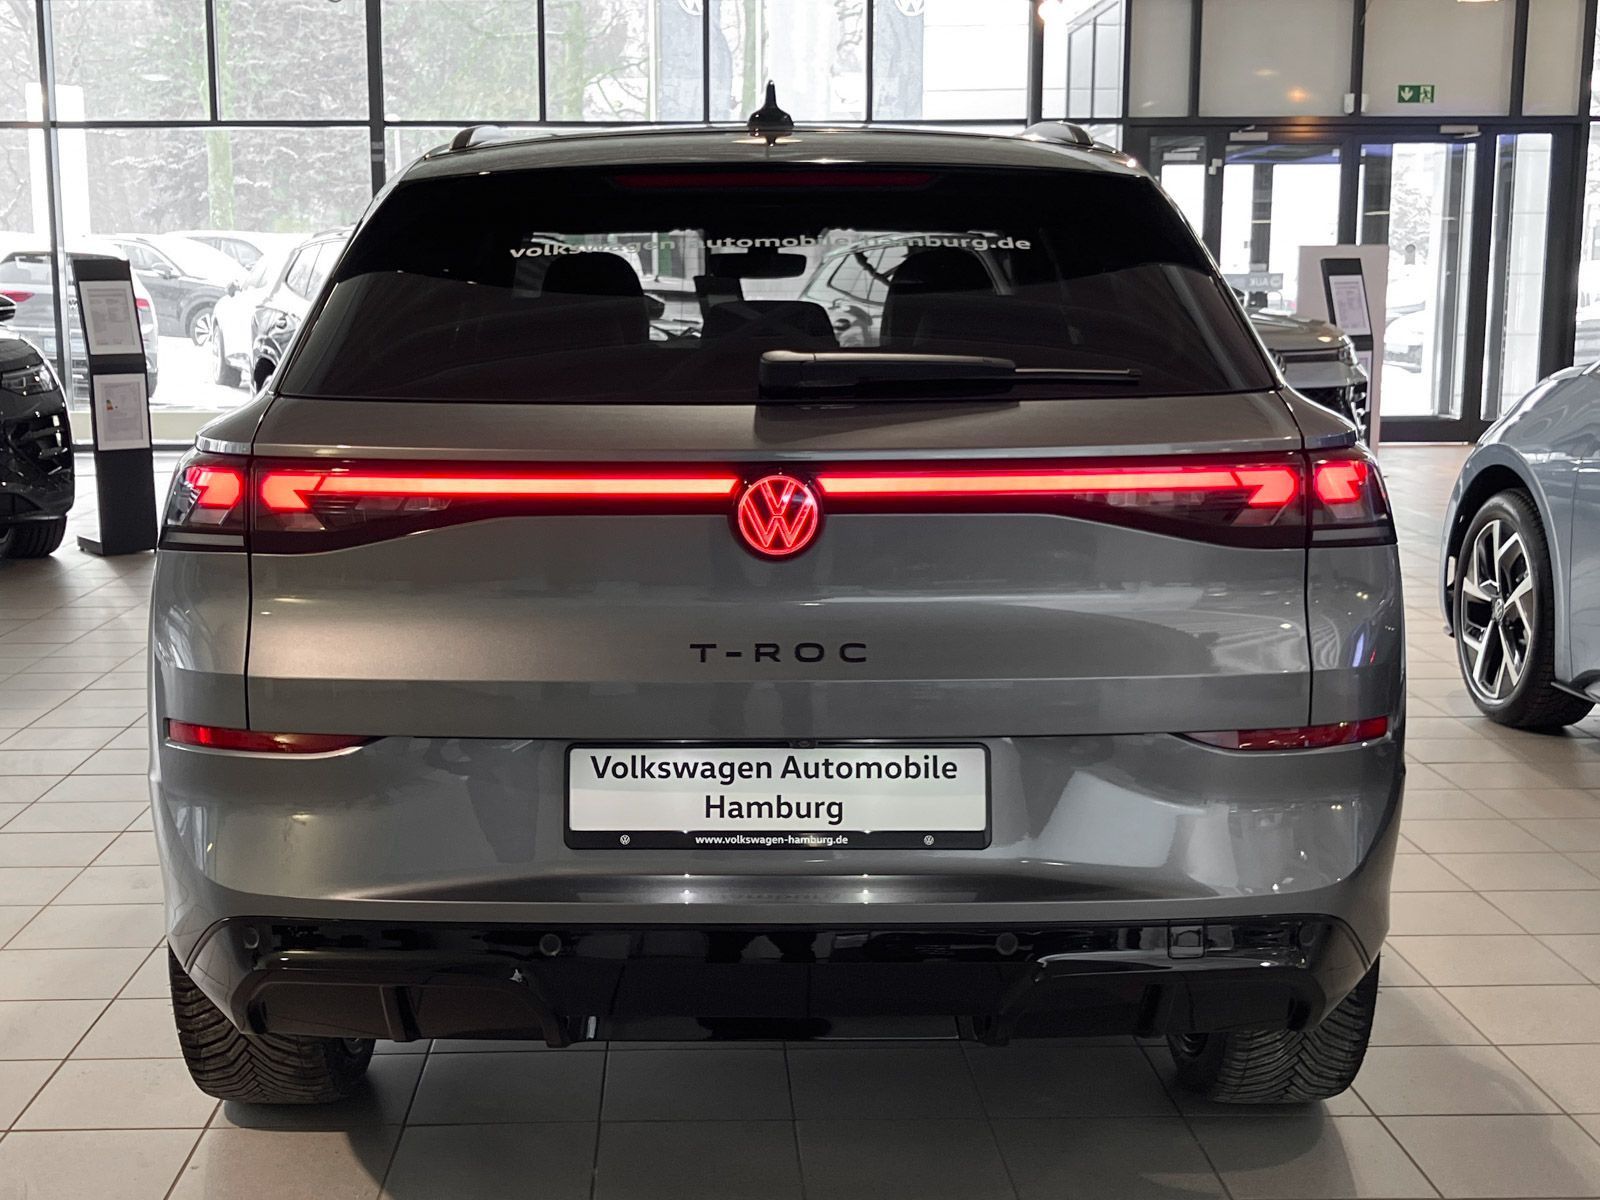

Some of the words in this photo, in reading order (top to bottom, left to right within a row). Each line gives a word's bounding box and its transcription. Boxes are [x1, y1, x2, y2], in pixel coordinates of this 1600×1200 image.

[689, 642, 867, 663] T-ROC
[591, 755, 772, 785] Volkswagen
[780, 755, 958, 780] Automobile
[705, 795, 844, 825] Hamburg
[695, 834, 849, 847] www.volkswagen-hamburg.de
